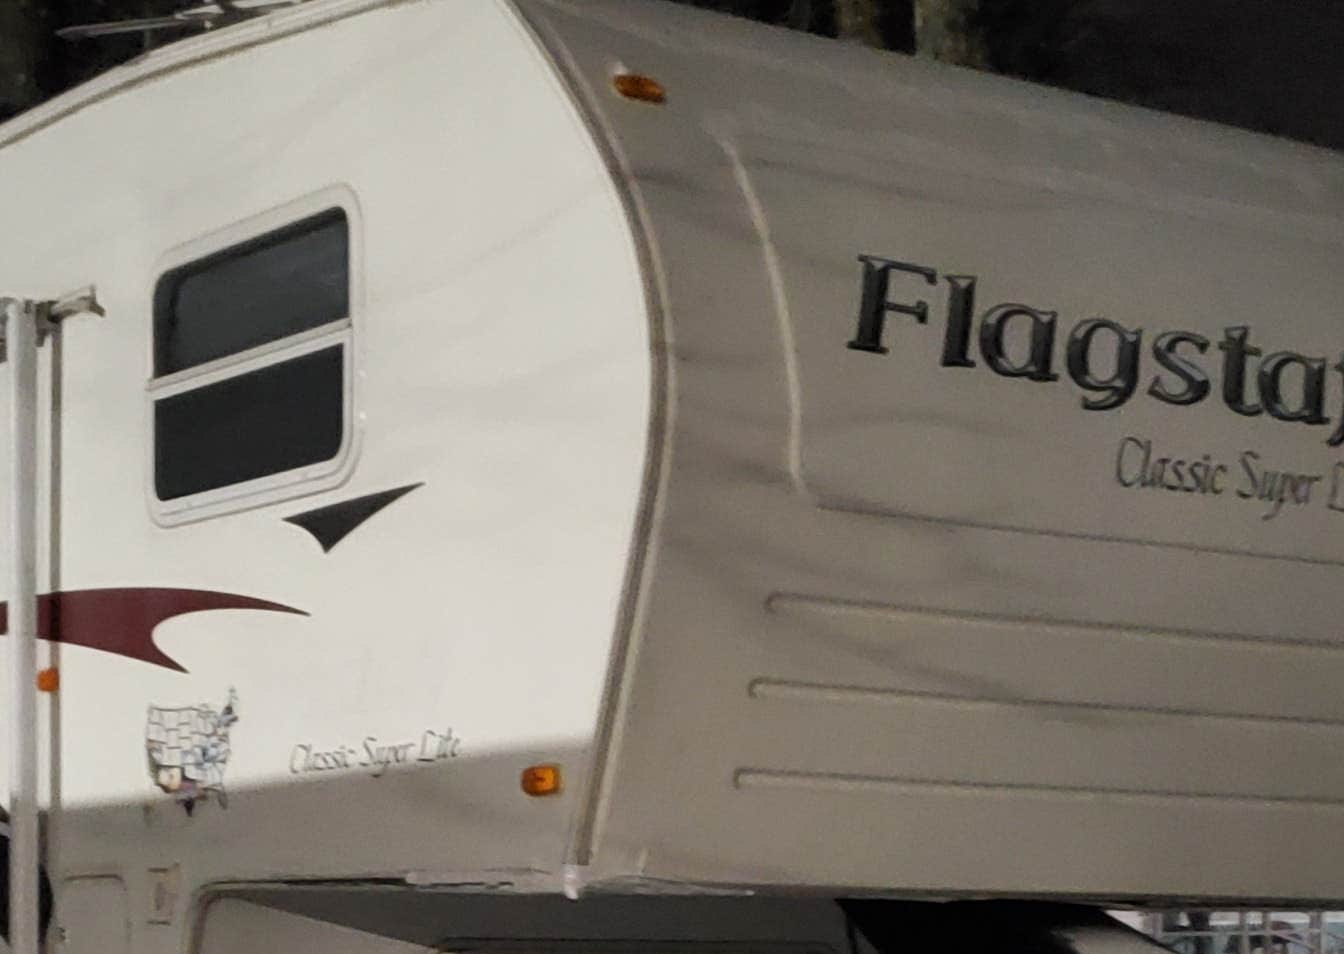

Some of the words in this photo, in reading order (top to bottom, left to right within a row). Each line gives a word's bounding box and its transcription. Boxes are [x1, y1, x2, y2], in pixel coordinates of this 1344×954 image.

[1116, 436, 1227, 495] Classic
[1236, 450, 1321, 521] Super
[290, 743, 355, 774] Classic
